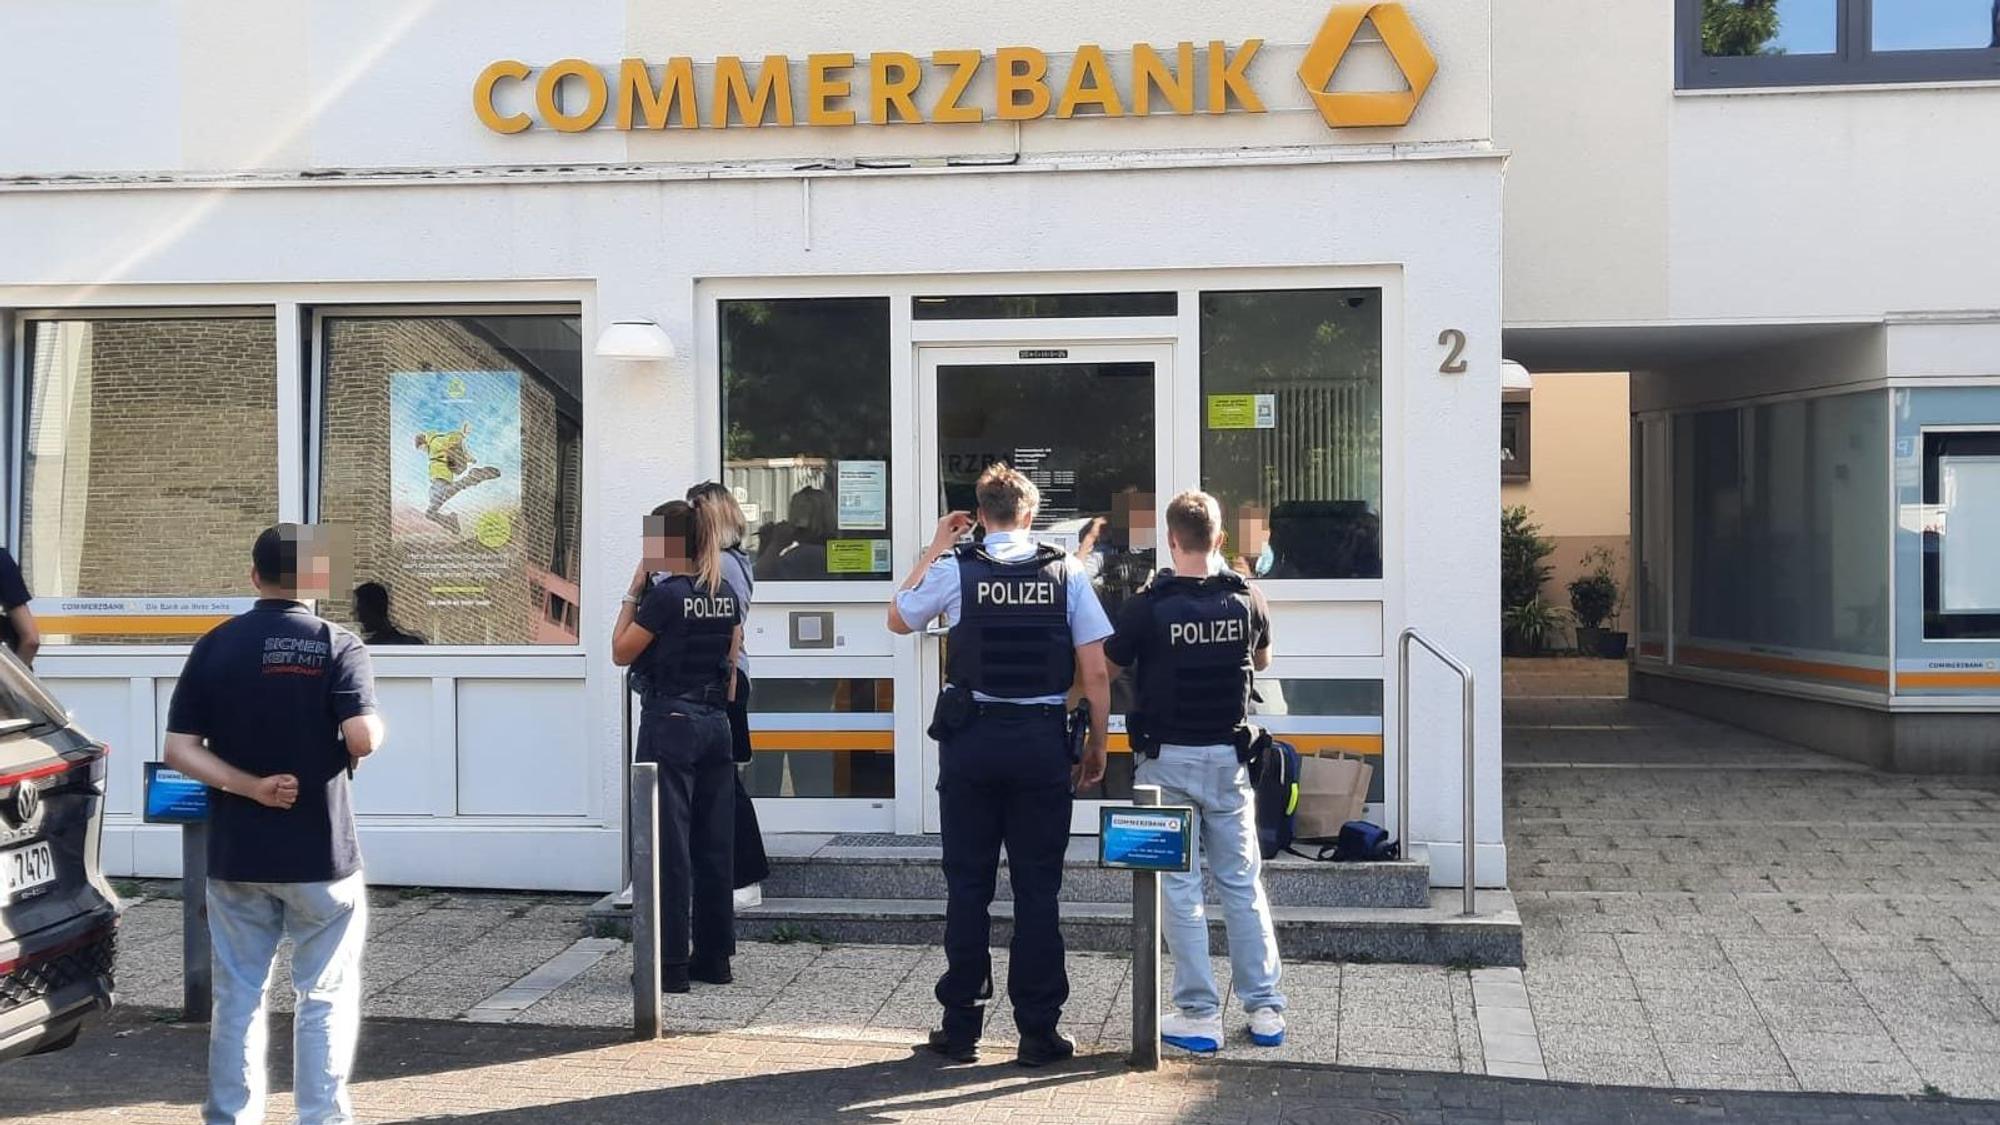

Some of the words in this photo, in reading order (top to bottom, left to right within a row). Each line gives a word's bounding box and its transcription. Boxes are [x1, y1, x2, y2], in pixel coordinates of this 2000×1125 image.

[472, 38, 1269, 134] COMMERZBANK
[1438, 329, 1467, 373] 2
[61, 602, 125, 610] COMMERZBANK
[977, 582, 1055, 604] POLIZEI
[683, 597, 735, 619] POLIZEI
[1170, 619, 1243, 646] POLIZEI
[14, 846, 50, 885] 7479
